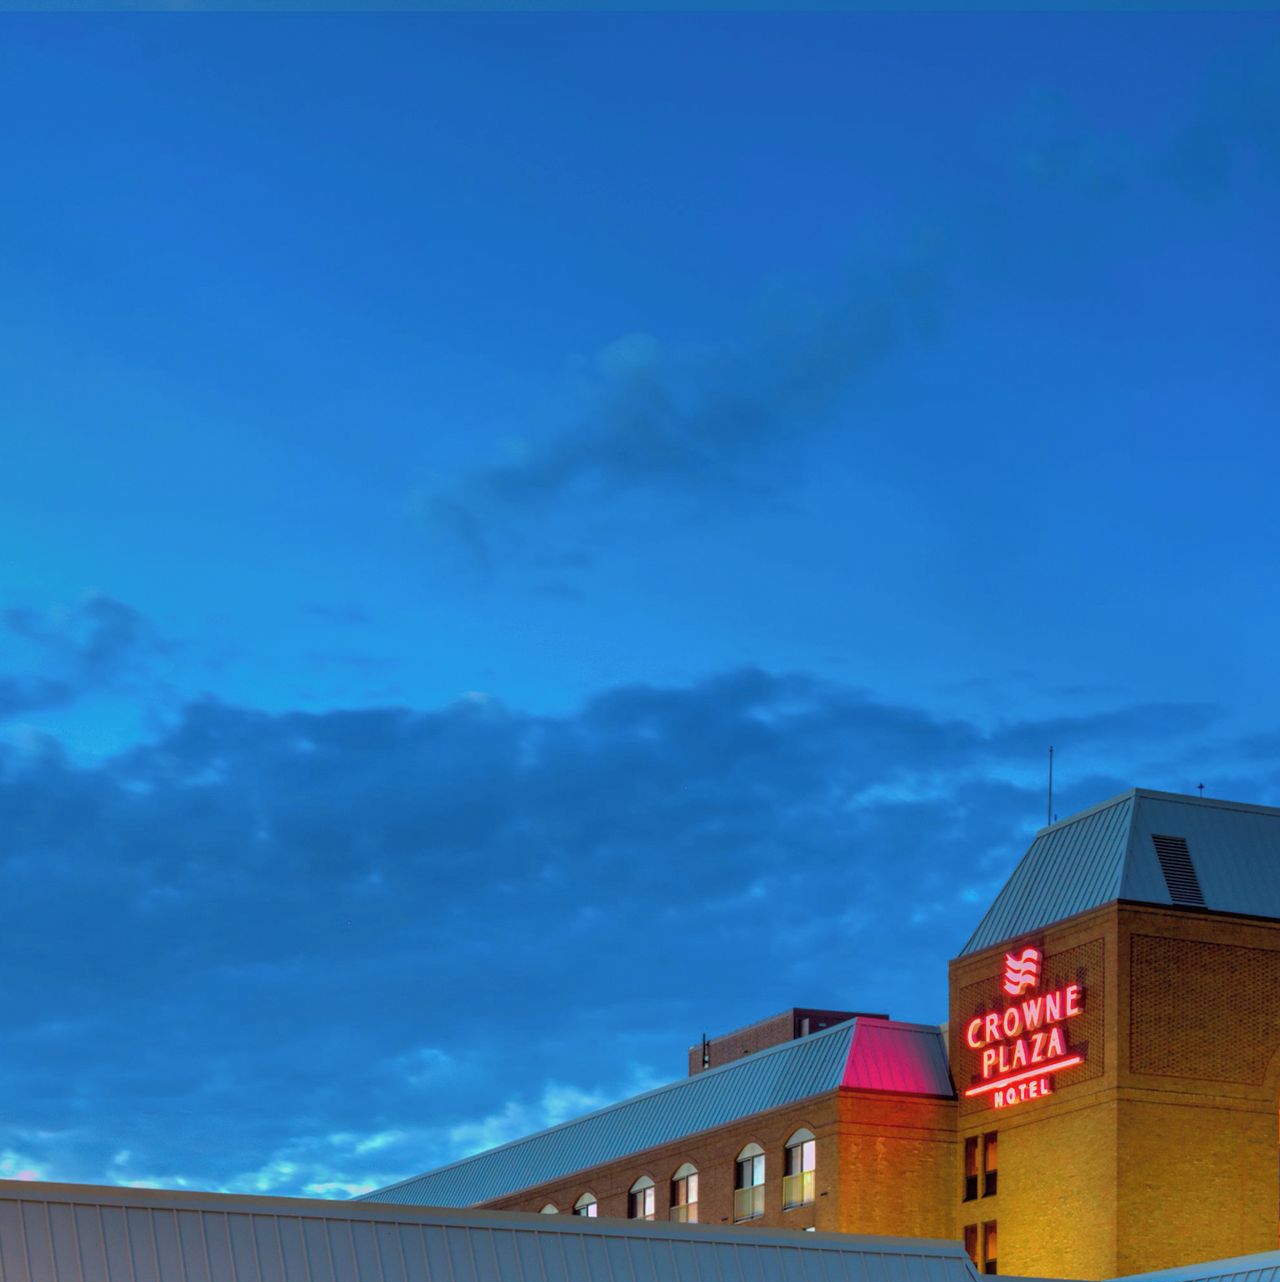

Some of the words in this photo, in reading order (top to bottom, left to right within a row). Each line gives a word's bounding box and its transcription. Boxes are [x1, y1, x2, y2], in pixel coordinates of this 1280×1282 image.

[967, 985, 1082, 1048] CROWNE
[983, 1028, 1064, 1078] PLAZA
[994, 1078, 1049, 1108] HOTEL
